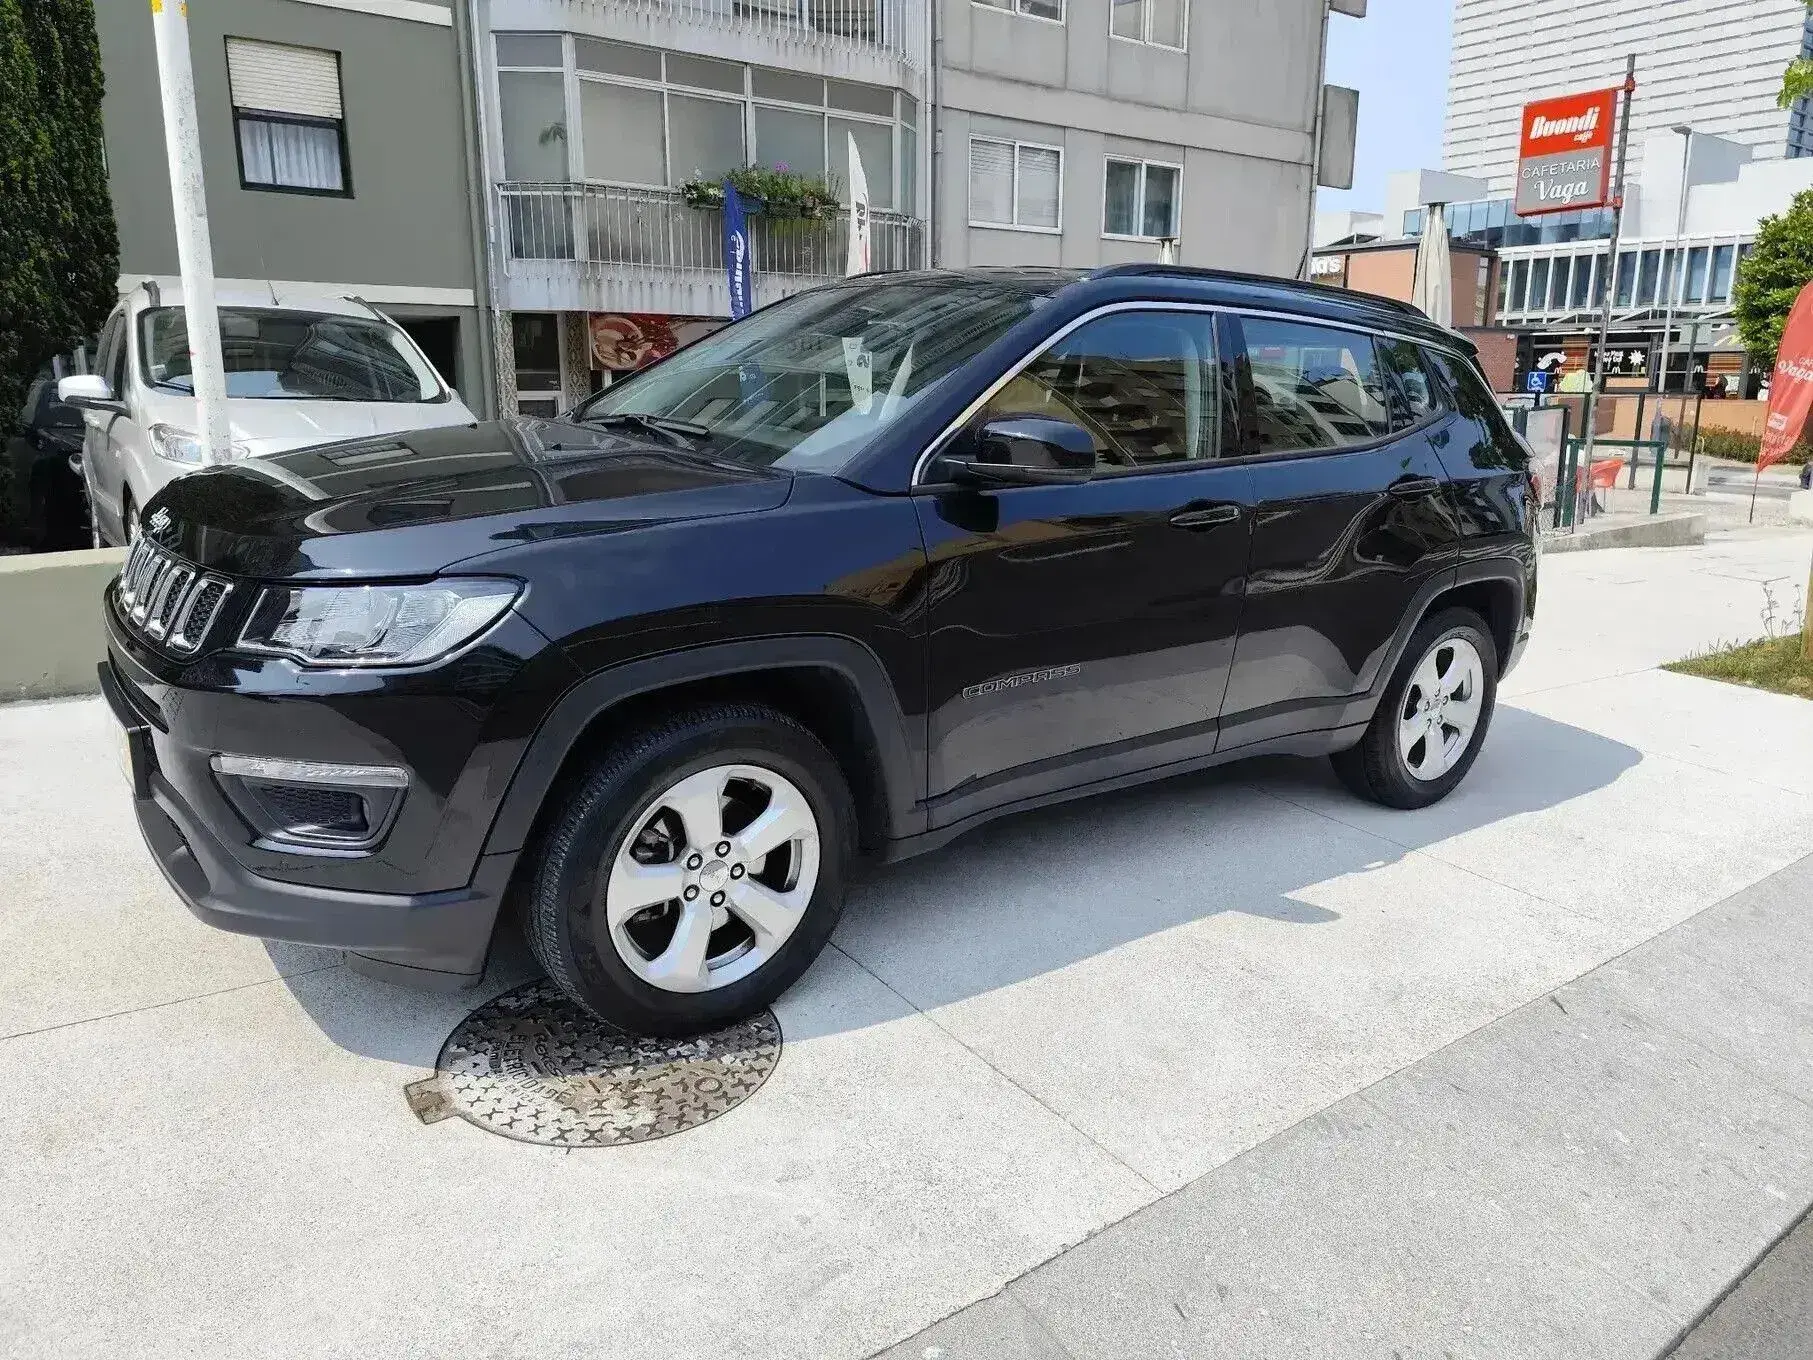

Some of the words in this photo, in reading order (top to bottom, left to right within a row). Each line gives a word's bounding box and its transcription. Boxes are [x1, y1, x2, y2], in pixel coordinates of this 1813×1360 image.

[1529, 106, 1600, 140] Buondi
[1521, 157, 1601, 180] CAFETARIA
[1533, 178, 1589, 205] Vaga
[962, 663, 1081, 699] COMPASS
